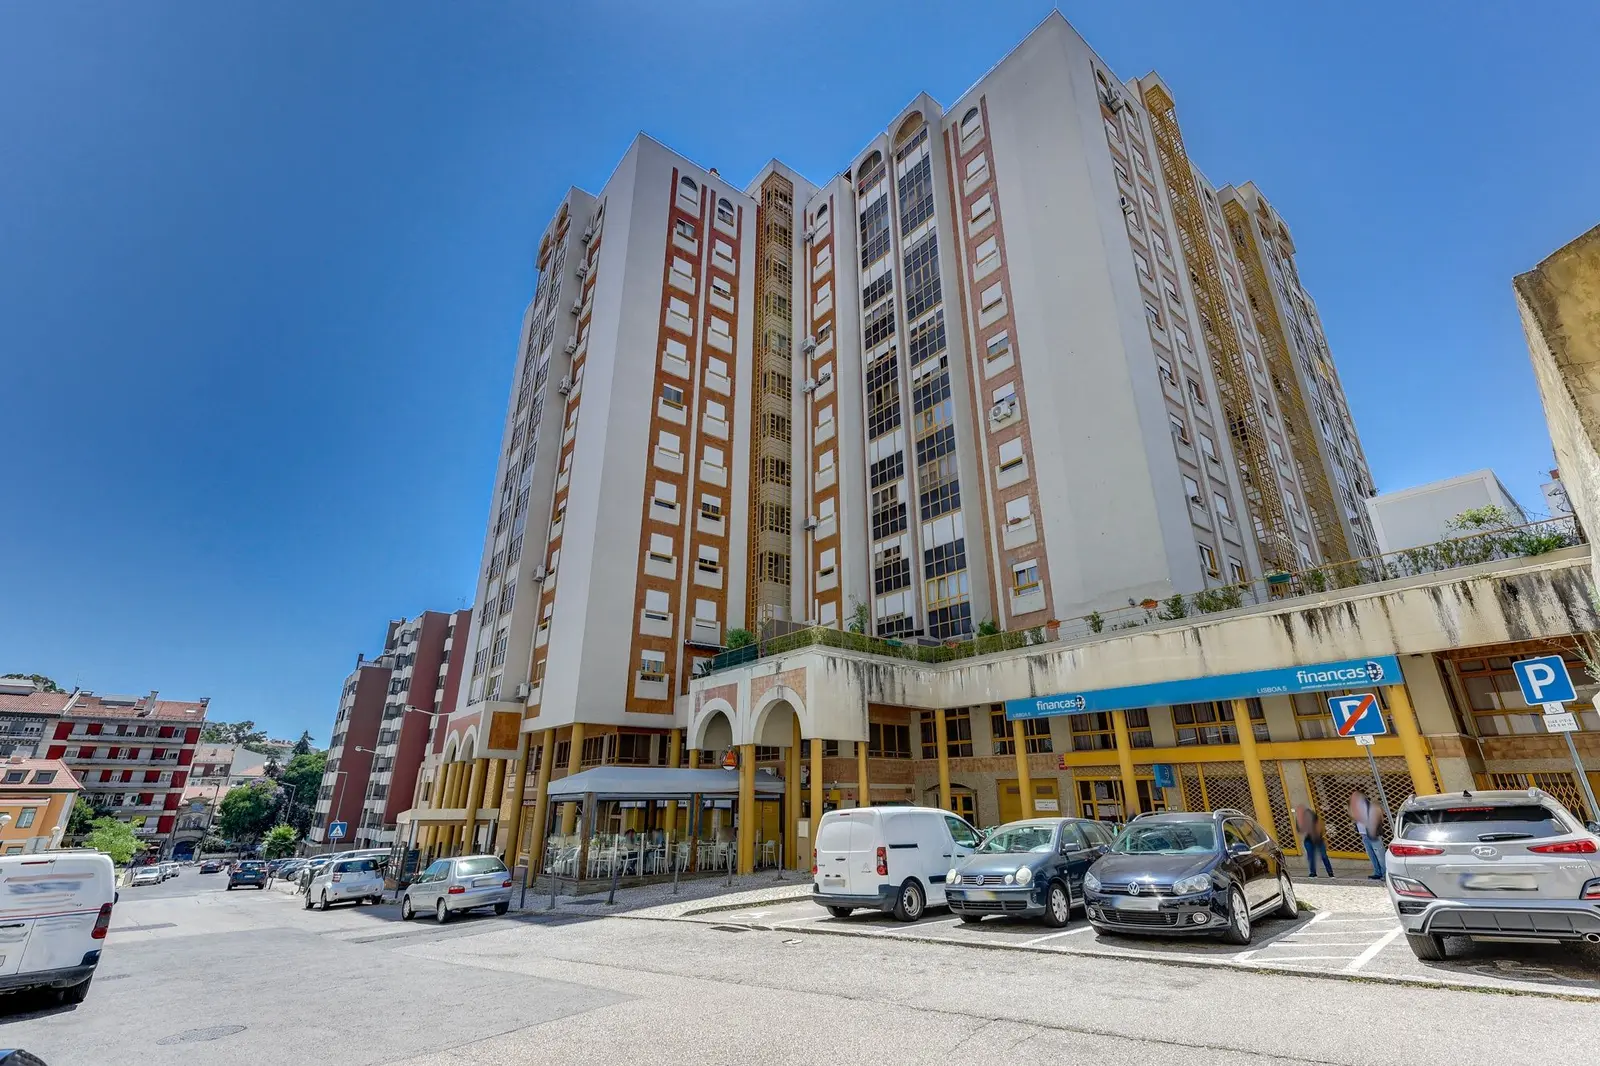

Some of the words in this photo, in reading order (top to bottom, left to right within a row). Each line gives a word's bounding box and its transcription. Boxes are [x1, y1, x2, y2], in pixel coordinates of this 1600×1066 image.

[1296, 667, 1366, 684] finanças
[1524, 663, 1555, 699] P
[1257, 686, 1282, 694] LISBOA
[1036, 698, 1076, 711] finanças
[1339, 700, 1368, 732] P
